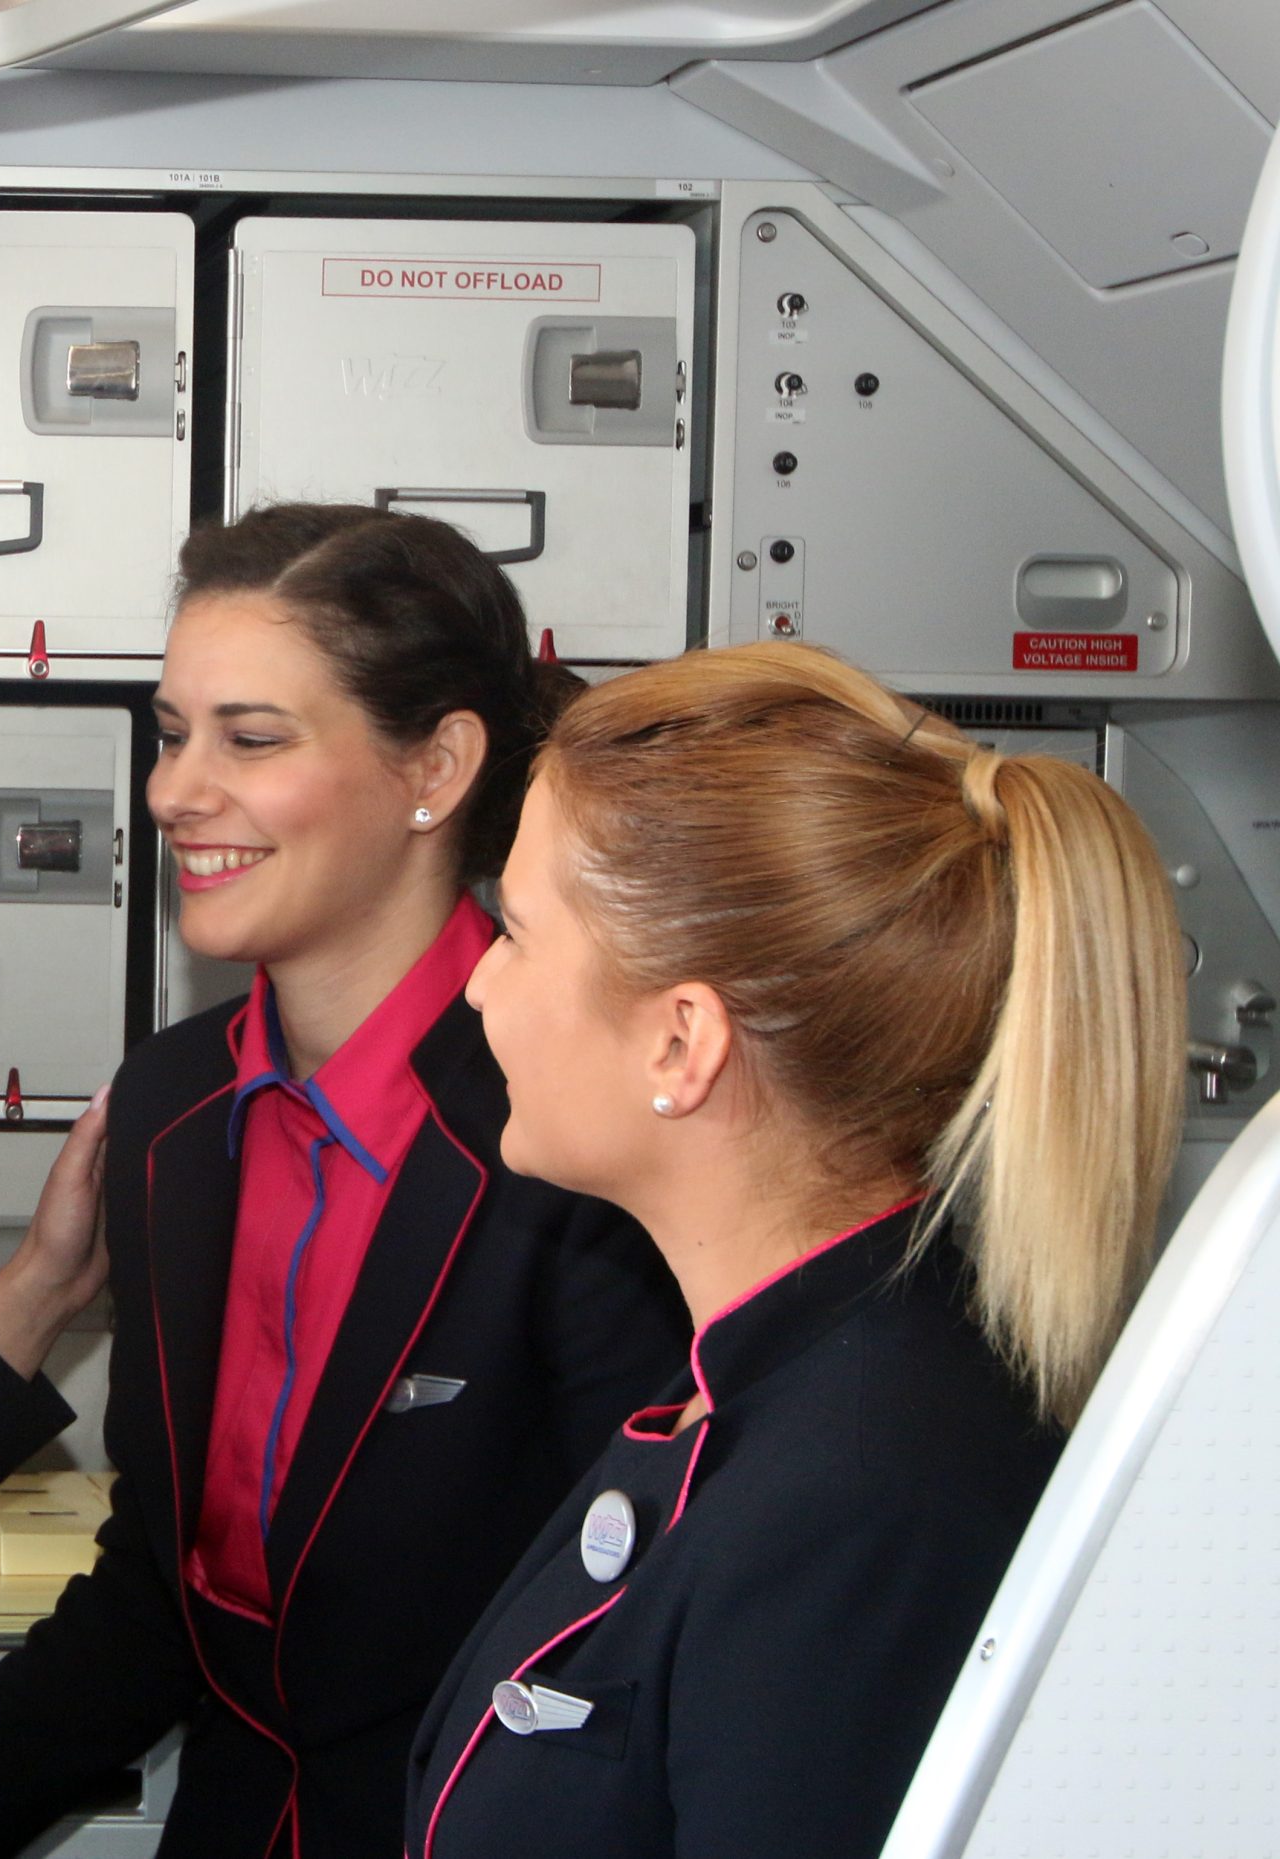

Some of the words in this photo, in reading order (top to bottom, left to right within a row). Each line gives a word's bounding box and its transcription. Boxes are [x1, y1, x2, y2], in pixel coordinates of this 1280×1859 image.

[169, 173, 191, 182] 101A
[198, 174, 221, 183] 101B
[678, 183, 693, 192] 102
[360, 269, 393, 288] DO
[400, 270, 448, 289] NOT
[454, 271, 564, 291] OFFLOAD
[765, 601, 800, 610] BRIGHT
[1029, 637, 1088, 650] CAUTION
[1090, 639, 1123, 651] HIGH
[1022, 653, 1082, 666] VOLTAGE
[1085, 654, 1129, 667] INSIDE
